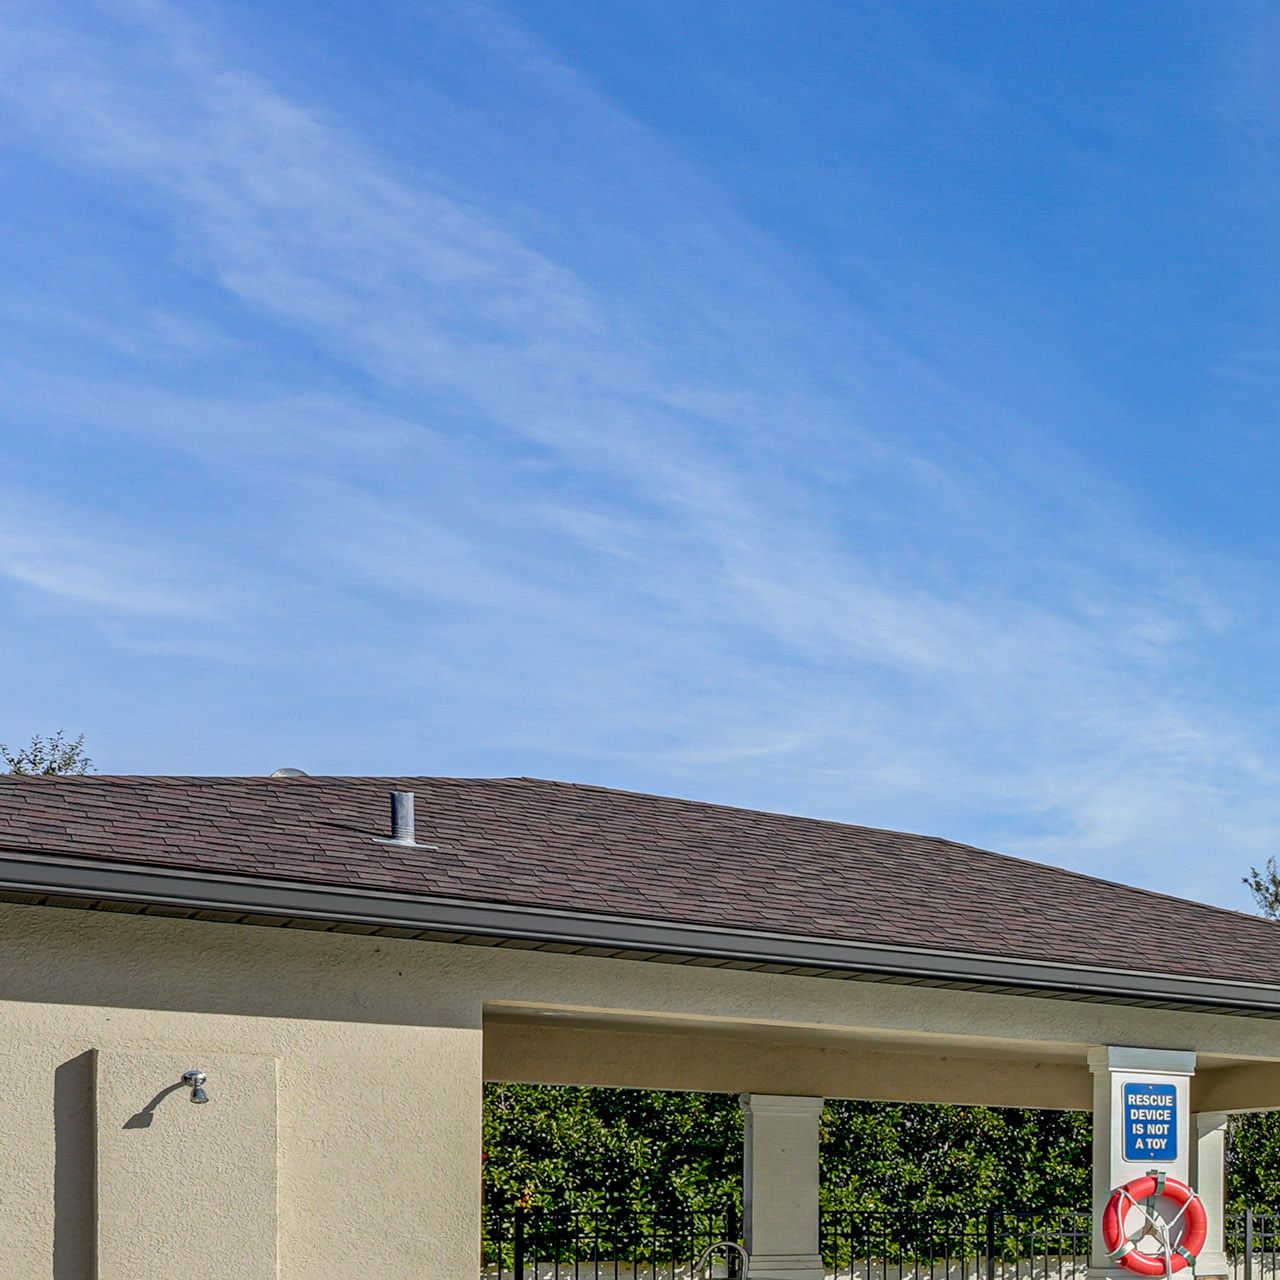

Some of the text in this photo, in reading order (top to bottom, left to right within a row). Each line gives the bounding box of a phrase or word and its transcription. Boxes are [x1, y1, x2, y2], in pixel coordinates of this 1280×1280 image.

[1128, 1094, 1173, 1106] RESCUE
[1130, 1109, 1171, 1120] DEVICE
[1132, 1123, 1170, 1135] IS NOT
[1135, 1138, 1168, 1149] A TOY
